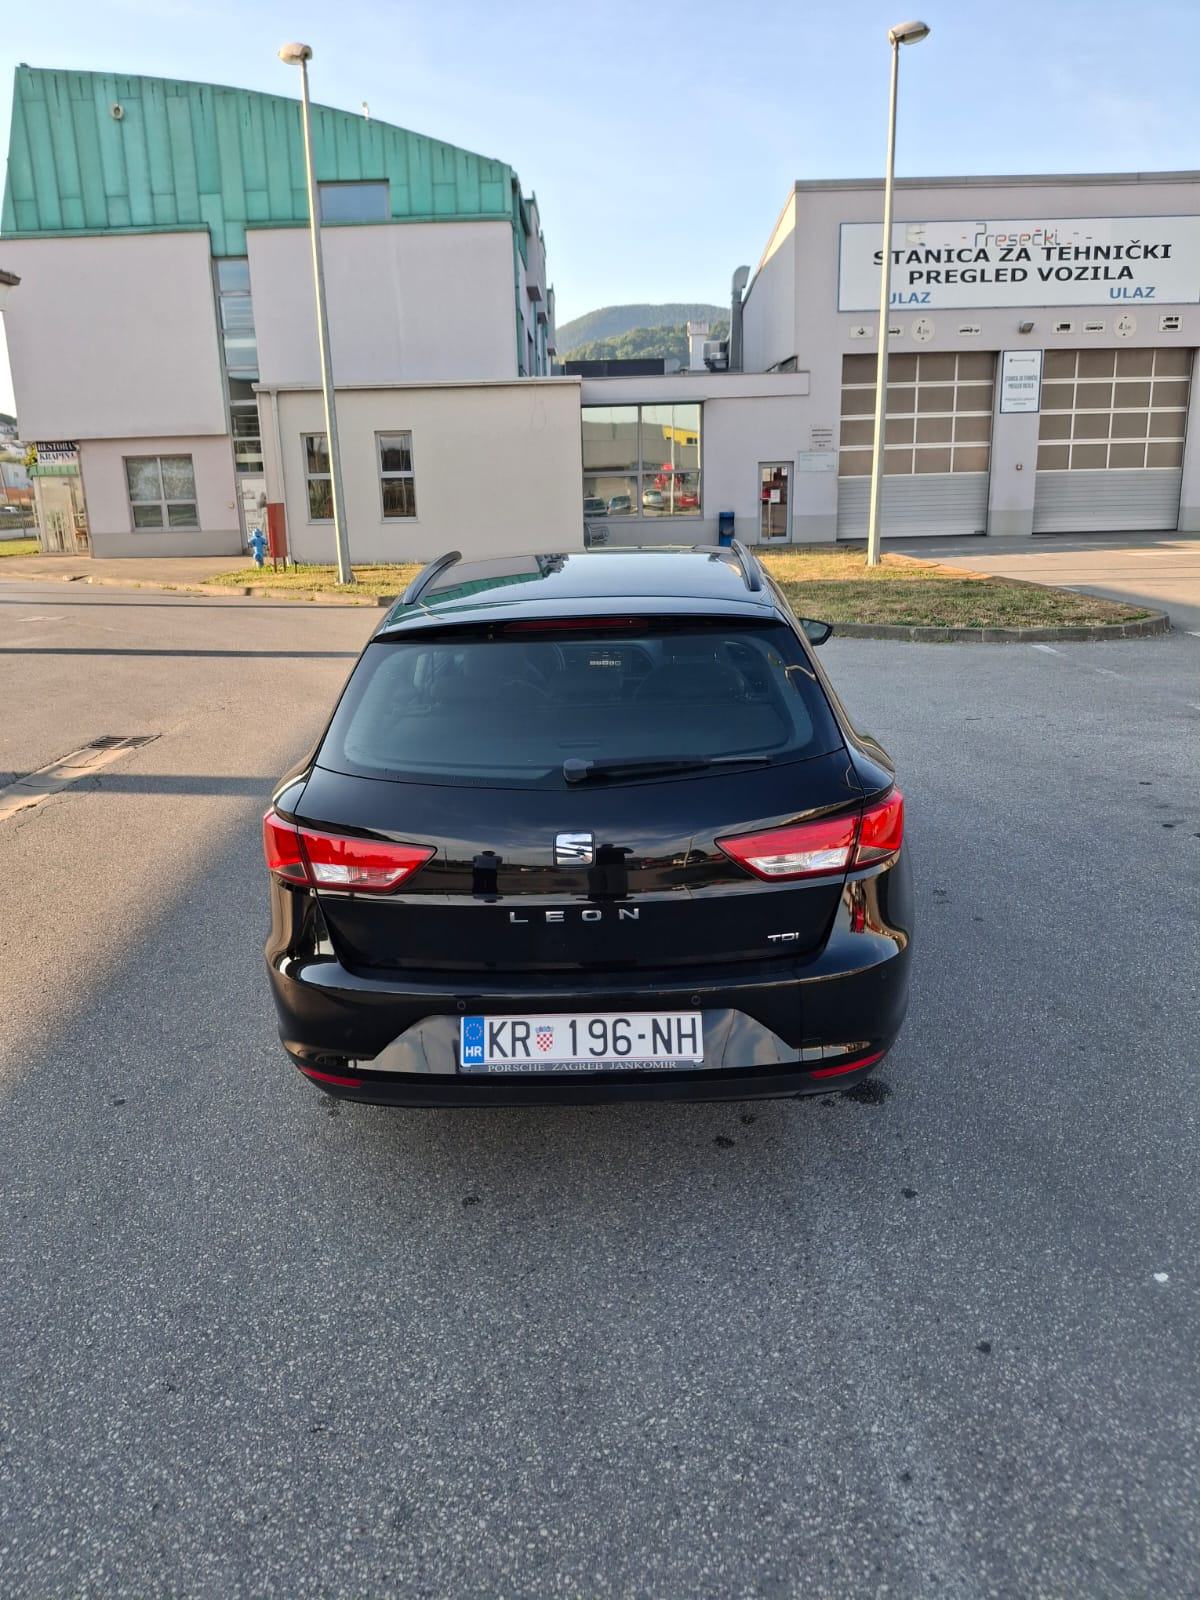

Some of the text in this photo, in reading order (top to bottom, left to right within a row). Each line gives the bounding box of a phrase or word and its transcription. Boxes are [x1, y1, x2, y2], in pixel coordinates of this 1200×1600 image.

[873, 240, 1172, 265] STANICA ZA TEHNIČKI
[909, 265, 1134, 285] PREGLED VOZILA
[1109, 286, 1156, 299] ULAZ
[509, 907, 640, 924] LEON
[767, 931, 799, 943] TDI
[488, 1020, 532, 1058] KR
[465, 1045, 483, 1058] HR
[488, 1060, 678, 1073] PORSCHE ZAGREB JANKOMIR
